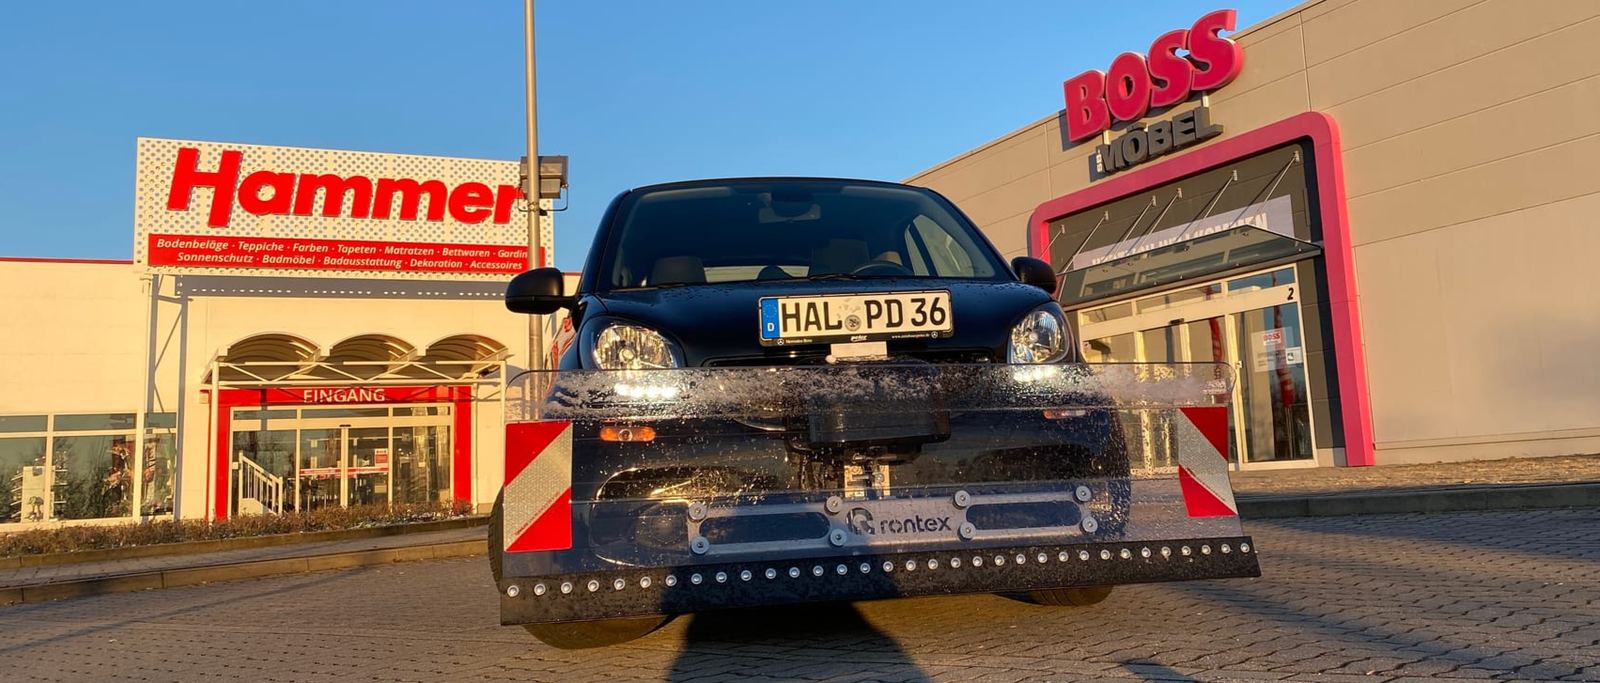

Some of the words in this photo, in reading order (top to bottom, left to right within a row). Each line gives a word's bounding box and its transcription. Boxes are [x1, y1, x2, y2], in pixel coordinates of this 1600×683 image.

[1063, 8, 1244, 142] BOSS
[1099, 106, 1223, 172] MÖBEL
[167, 147, 526, 228] Hammer
[157, 239, 229, 251] Bodenbeläge
[238, 241, 284, 253] Teppiche
[292, 242, 329, 253] Farben
[337, 244, 376, 255] Tapeten
[384, 246, 434, 256] Matratzen
[442, 247, 490, 257] Bettwaren
[498, 249, 528, 258] Gardin
[177, 252, 253, 263] Sonnenschutz
[262, 253, 315, 264] Badmöbel
[323, 256, 402, 269] Badausstattung
[410, 257, 462, 268] Dekoration
[470, 259, 522, 270] Accessoires
[1287, 287, 1294, 300] 2
[781, 301, 842, 333] HAL
[864, 298, 903, 329] PD
[911, 297, 946, 327] 36
[767, 322, 775, 332] D
[303, 388, 385, 403] EINGANG
[880, 514, 951, 534] rontex
